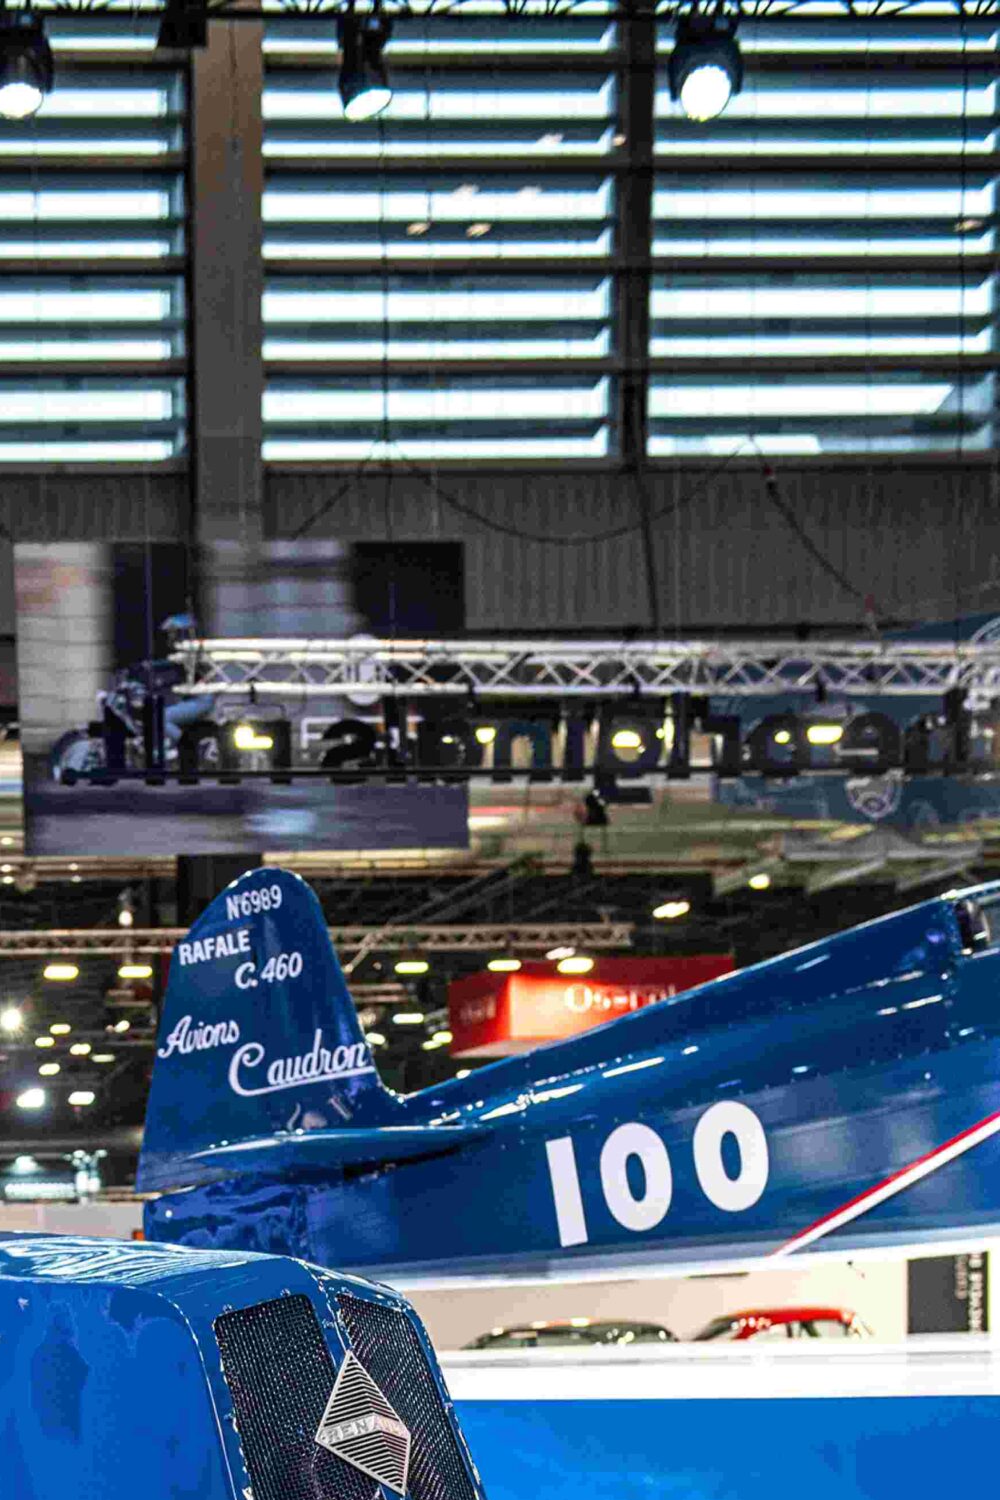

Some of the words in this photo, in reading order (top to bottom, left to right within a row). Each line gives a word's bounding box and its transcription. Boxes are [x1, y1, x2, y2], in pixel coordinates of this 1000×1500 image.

[178, 929, 252, 966] RAFALE
[157, 1014, 240, 1059] Avions
[228, 1028, 376, 1097] Caudron
[545, 1100, 769, 1248] 100
